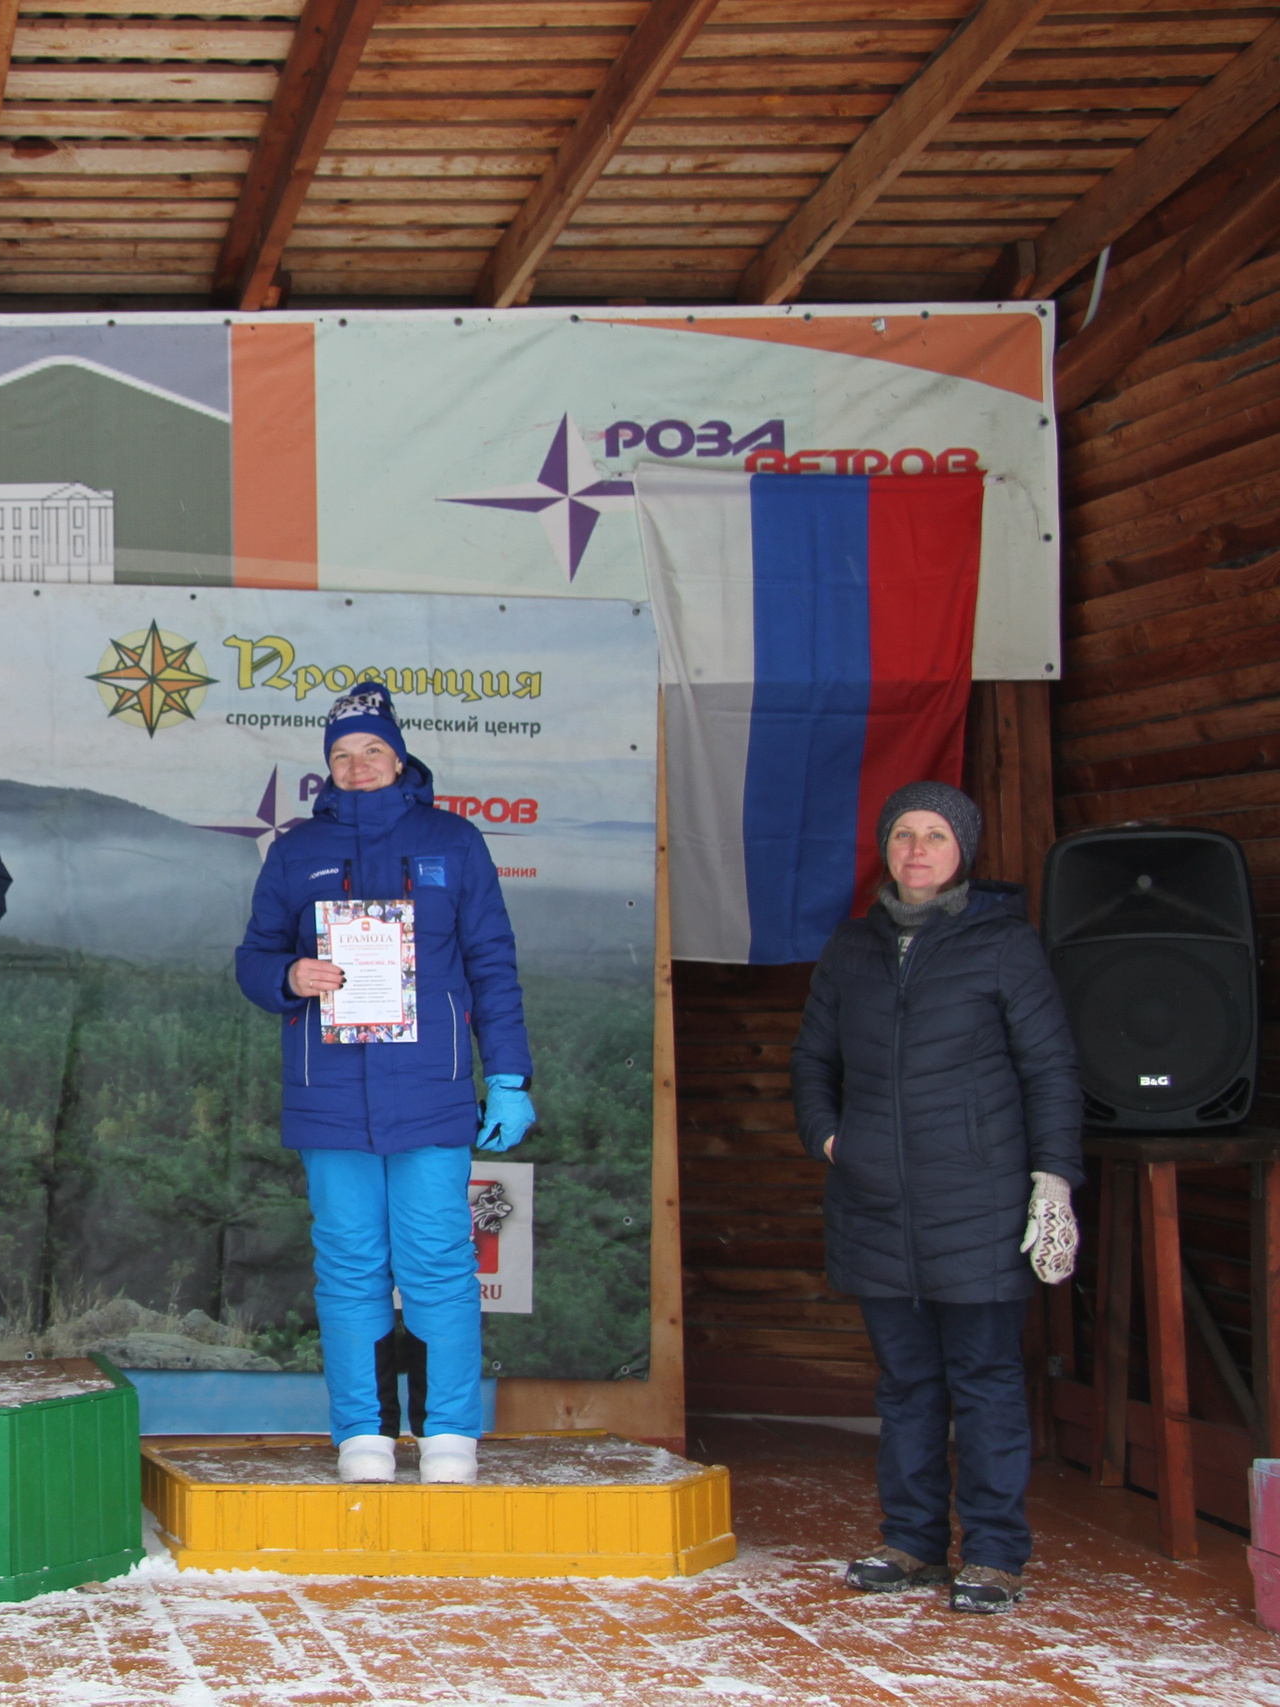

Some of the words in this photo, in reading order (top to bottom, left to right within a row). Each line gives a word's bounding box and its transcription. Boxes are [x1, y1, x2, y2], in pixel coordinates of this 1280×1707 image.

[605, 419, 785, 458] РОЗА
[223, 634, 543, 702] Провинция
[484, 717, 542, 737] центр
[433, 795, 539, 824] ТРОВ
[338, 933, 394, 944] ГРАМОТА
[1140, 1076, 1169, 1086] B&G
[480, 1284, 502, 1300] RU
